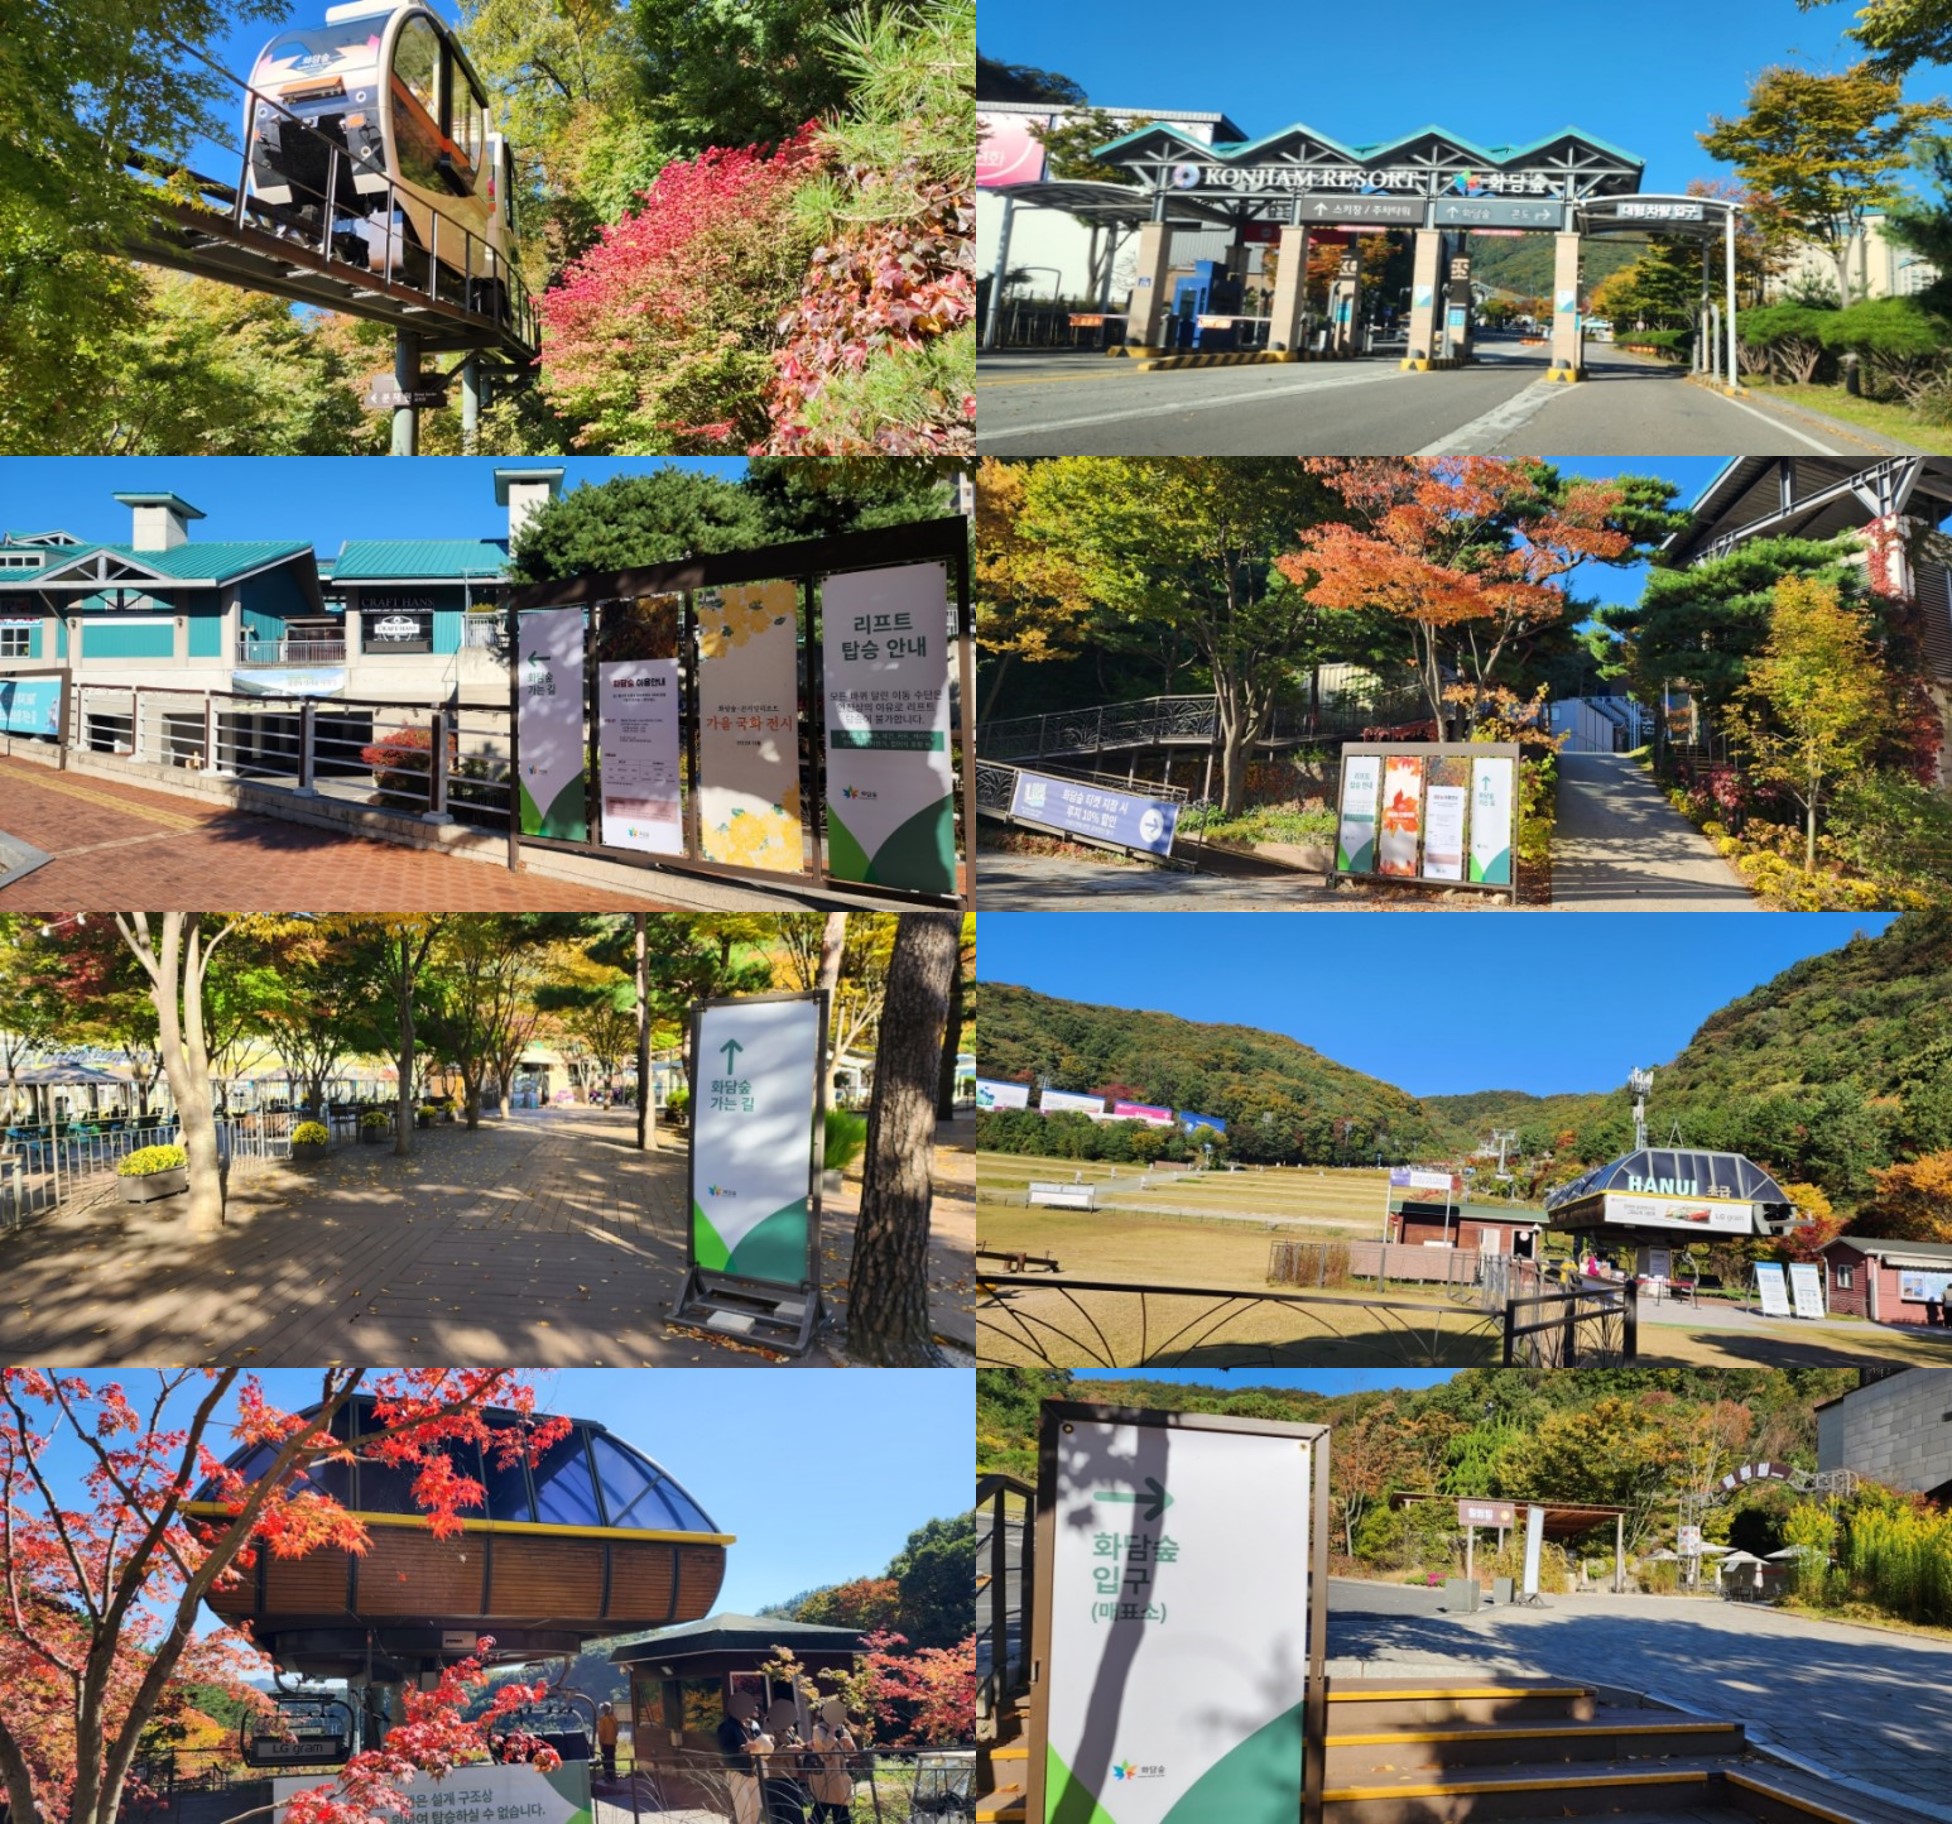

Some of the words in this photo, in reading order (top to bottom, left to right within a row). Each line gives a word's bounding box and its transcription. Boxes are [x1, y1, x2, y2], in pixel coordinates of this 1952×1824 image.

[1205, 167, 1313, 187] KONJIAM
[1321, 169, 1420, 189] RESORT
[1487, 172, 1550, 193] 화담숲
[1332, 204, 1361, 216] 스키장
[1372, 204, 1411, 217] 주차타워
[1462, 207, 1492, 220] 화담숲
[1511, 207, 1530, 220] 콘도
[1674, 204, 1699, 219] 입구
[361, 597, 398, 608] CRAFT
[402, 597, 434, 608] HANS
[854, 612, 913, 635] 리프트
[842, 639, 880, 661] 탑승
[886, 635, 926, 659] 안내
[527, 672, 554, 684] 화담숲
[528, 685, 545, 697] 가는
[547, 684, 556, 696] 길
[830, 690, 847, 701] 모든
[871, 689, 889, 701] 달린
[892, 689, 911, 701] 이동
[914, 688, 941, 701] 수단은
[876, 701, 904, 713] 이유로
[907, 701, 937, 712] 리프트
[706, 715, 732, 731] 가을
[736, 715, 763, 731] 국화
[766, 715, 793, 732] 전시
[875, 713, 926, 725] 불가합니다.
[711, 1080, 752, 1096] 화담숲
[711, 1096, 738, 1112] 가는
[741, 1096, 755, 1112] 길
[1627, 1175, 1698, 1197] HANUI
[1706, 1184, 1732, 1199] 초급
[1715, 1212, 1725, 1221] LG
[1092, 1532, 1180, 1563] 화담숲
[1092, 1565, 1150, 1596] 입구
[1091, 1600, 1168, 1625] (매표소)
[273, 1743, 290, 1754] LG
[292, 1743, 323, 1755] gram
[1141, 1764, 1166, 1775] 화담숲
[458, 1788, 493, 1805] 구조상
[432, 1808, 479, 1824] 탑승하실
[482, 1807, 494, 1821] 수
[497, 1803, 546, 1821] 없습니다.
